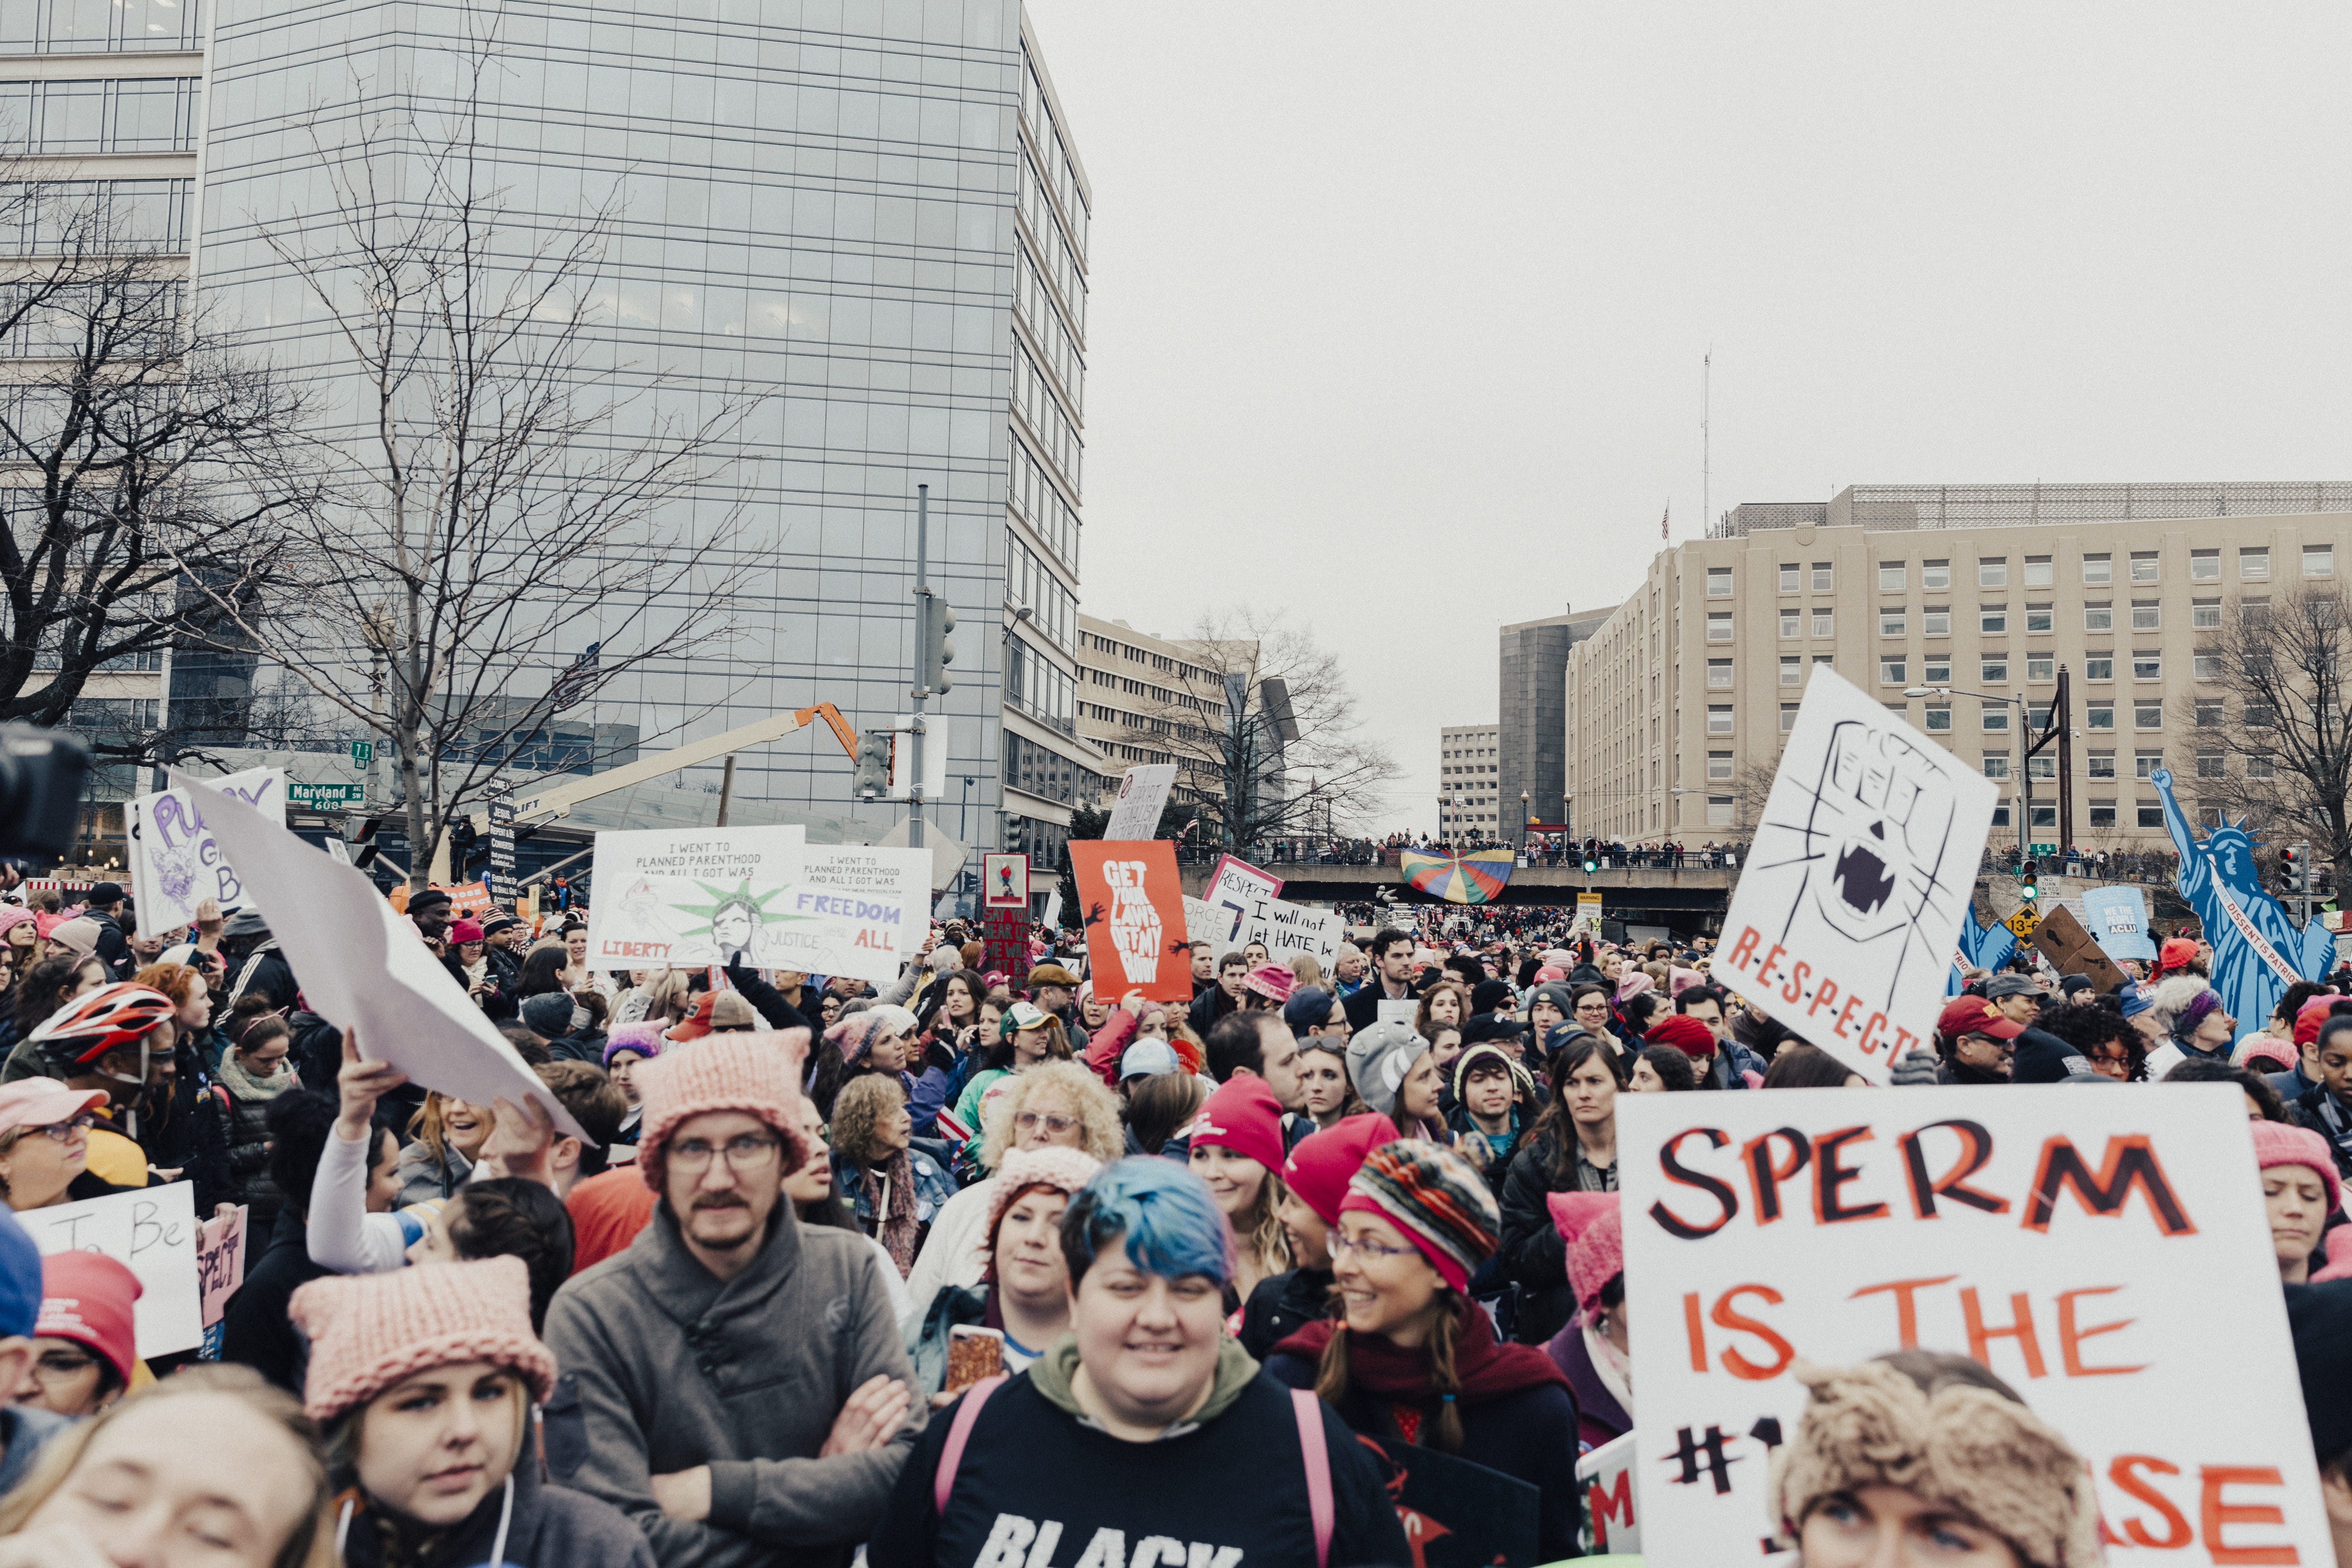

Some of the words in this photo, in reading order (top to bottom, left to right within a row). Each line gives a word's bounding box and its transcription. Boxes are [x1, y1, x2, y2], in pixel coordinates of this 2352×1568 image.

[357, 759, 365, 768] 200
[294, 785, 346, 799] Maryland
[500, 794, 514, 806] LORD
[154, 778, 273, 849] PUY
[490, 825, 505, 836] REPENT
[509, 829, 515, 839] BE
[491, 838, 514, 851] CONVERTED
[669, 843, 675, 854] I
[679, 842, 711, 853] WENT
[716, 842, 730, 852] TO
[636, 857, 685, 868] PLANNED
[689, 854, 761, 866] PARENTHOOD
[837, 857, 862, 865] WENT
[865, 857, 876, 865] TO
[492, 874, 504, 883] EVERY
[512, 877, 517, 885] OF
[703, 868, 723, 877] GOT
[728, 867, 754, 877] WAS
[804, 865, 842, 874] PLANNED
[845, 867, 900, 876] PARENTHOOD
[1103, 860, 1147, 887] GET
[830, 876, 845, 884] ALL
[856, 877, 871, 885] GOT
[498, 886, 509, 894] SHALL
[1112, 886, 1151, 905] YOUR
[494, 896, 511, 905] ACCOUNT
[797, 893, 901, 925] FREEDOM
[983, 907, 1005, 922] SAY
[1009, 907, 1030, 923] YOU
[1110, 904, 1161, 927] LAWS
[1183, 903, 1226, 926] ORCE
[1251, 900, 1268, 920] I
[1274, 910, 1299, 925] will
[1301, 918, 1326, 931] not
[2103, 906, 2117, 916] WE
[2118, 906, 2133, 915] THE
[2106, 915, 2136, 925] PEOPLE
[983, 923, 1013, 940] HEAR
[1015, 924, 1030, 942] US
[2110, 924, 2137, 934] ACLU
[602, 940, 673, 958] LIBERTY
[771, 931, 821, 950] JUSTICE
[854, 929, 894, 951] ALL
[1110, 926, 1141, 952] OFF
[1138, 925, 1162, 958] MY
[1249, 925, 1270, 944] let
[1275, 929, 1315, 953] HATE
[1321, 941, 1334, 958] be
[2227, 903, 2261, 944] DISSENT
[2259, 943, 2269, 954] IS
[2268, 952, 2301, 983] PATRIO
[1119, 949, 1159, 984] BODY
[1649, 1118, 2199, 1240] SPERM
[131, 1201, 186, 1259] Be
[1683, 1283, 1795, 1380] IS
[1849, 1274, 2155, 1379] THE
[973, 1512, 1244, 1568] BLACK
